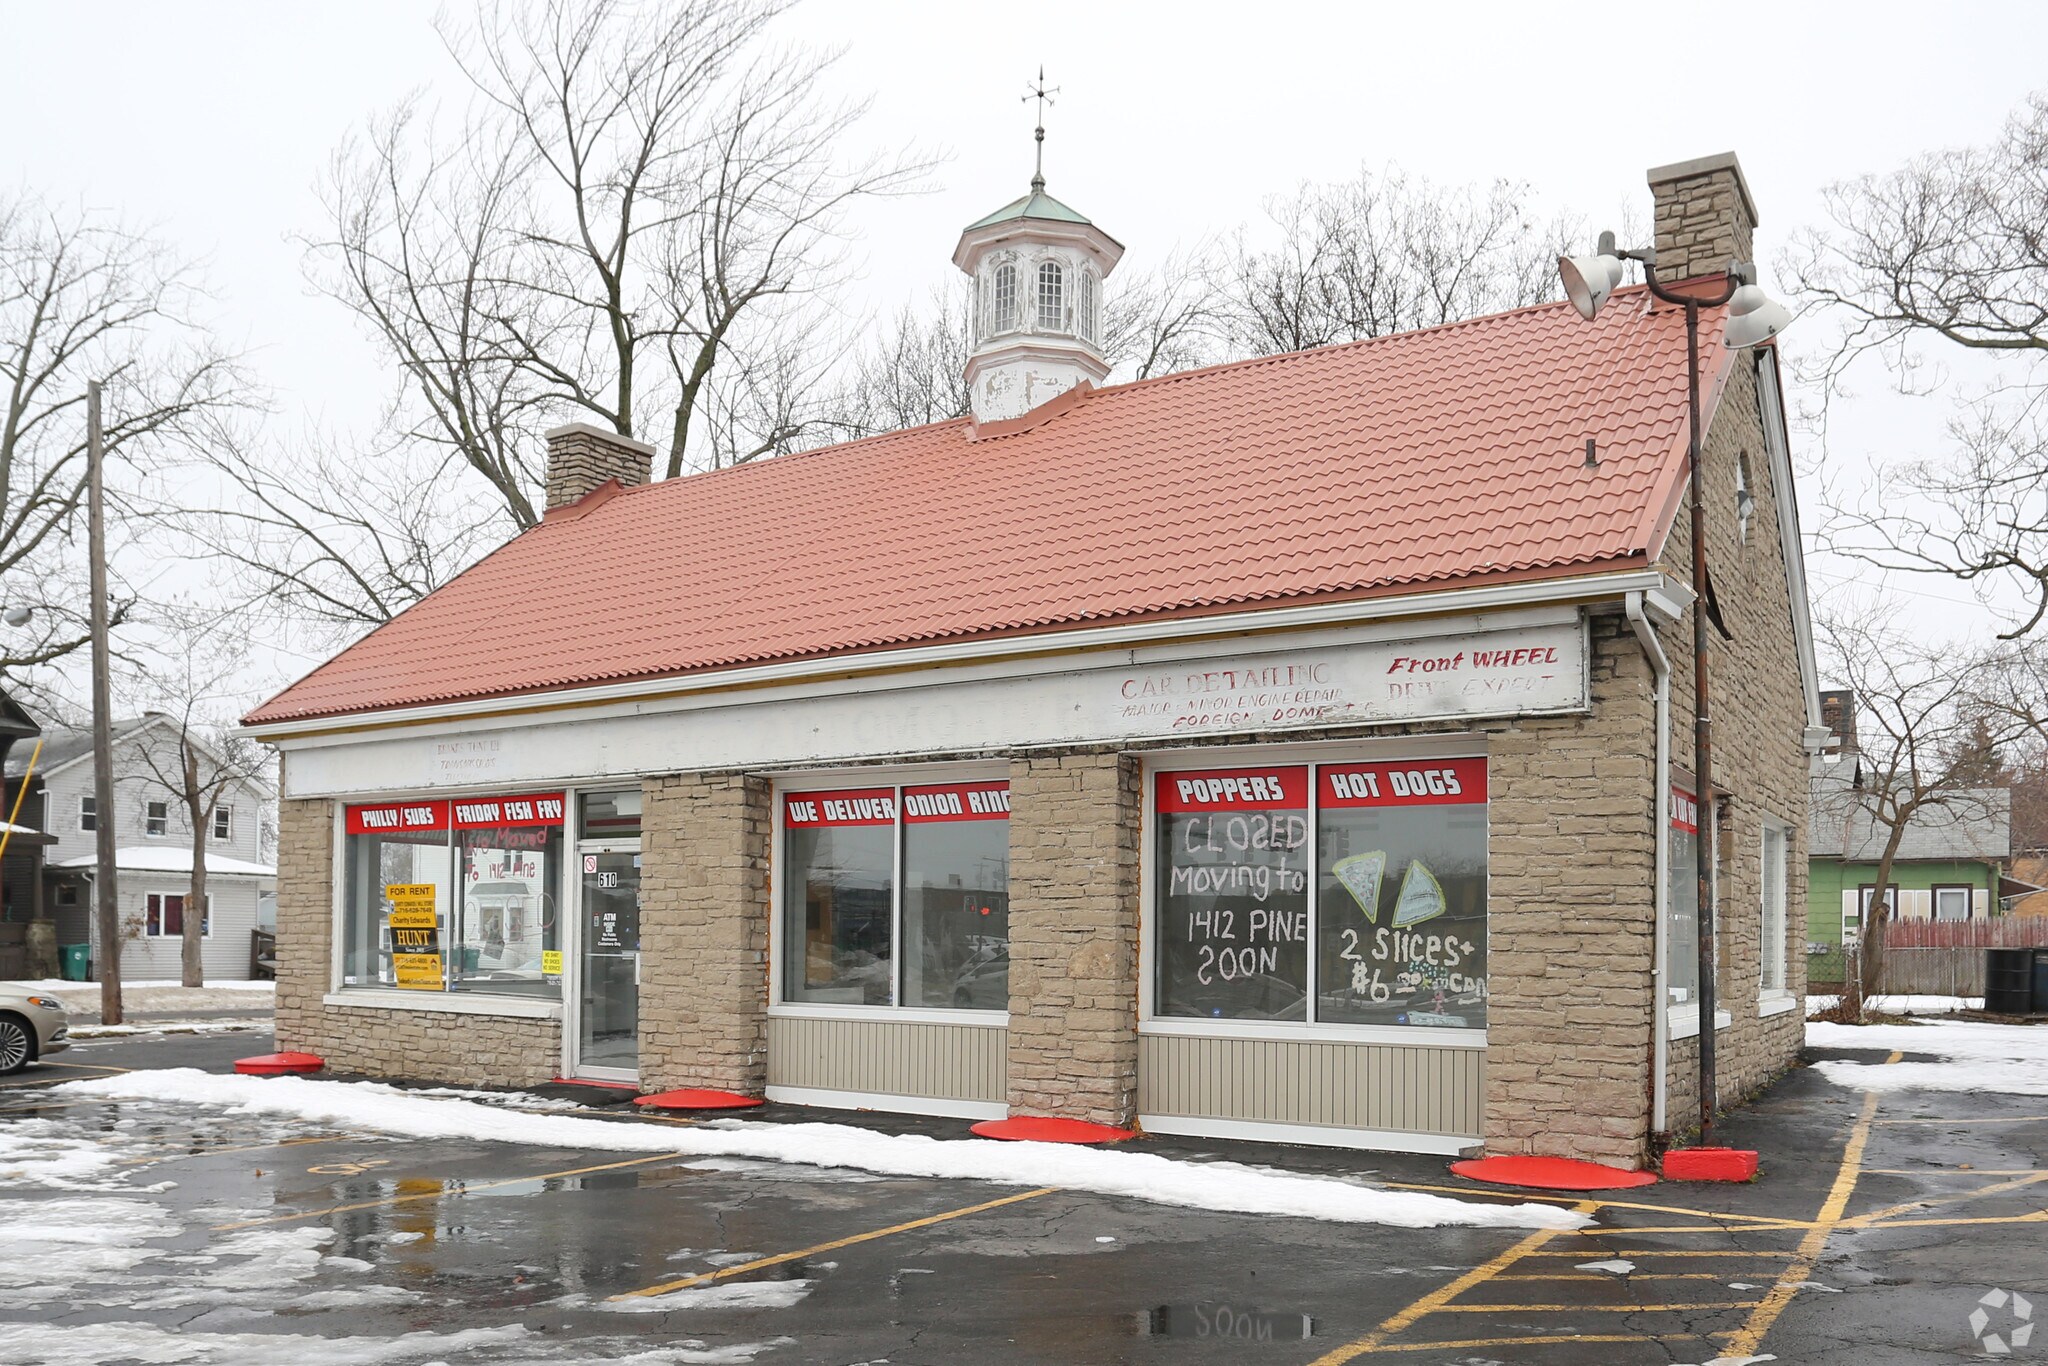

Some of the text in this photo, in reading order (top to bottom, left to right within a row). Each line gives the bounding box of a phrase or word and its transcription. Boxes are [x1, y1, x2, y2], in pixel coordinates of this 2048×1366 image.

[1387, 647, 1559, 674] Front WHEEL
[1177, 776, 1285, 803] POPPERS
[1330, 769, 1461, 799] HOT DOGS
[455, 800, 562, 823] FRIDAY FISH FRY
[789, 798, 896, 822] WE DELIVER
[904, 793, 963, 817] ONION
[1185, 815, 1308, 853] CLOSED
[599, 873, 616, 887] 610
[1276, 857, 1304, 893] to
[390, 887, 430, 896] FOR RENT
[603, 913, 617, 921] ATM
[1188, 910, 1308, 943] 1412 PINE
[396, 930, 430, 946] HUNT
[1340, 929, 1362, 961] 2
[1197, 945, 1278, 985] SOON
